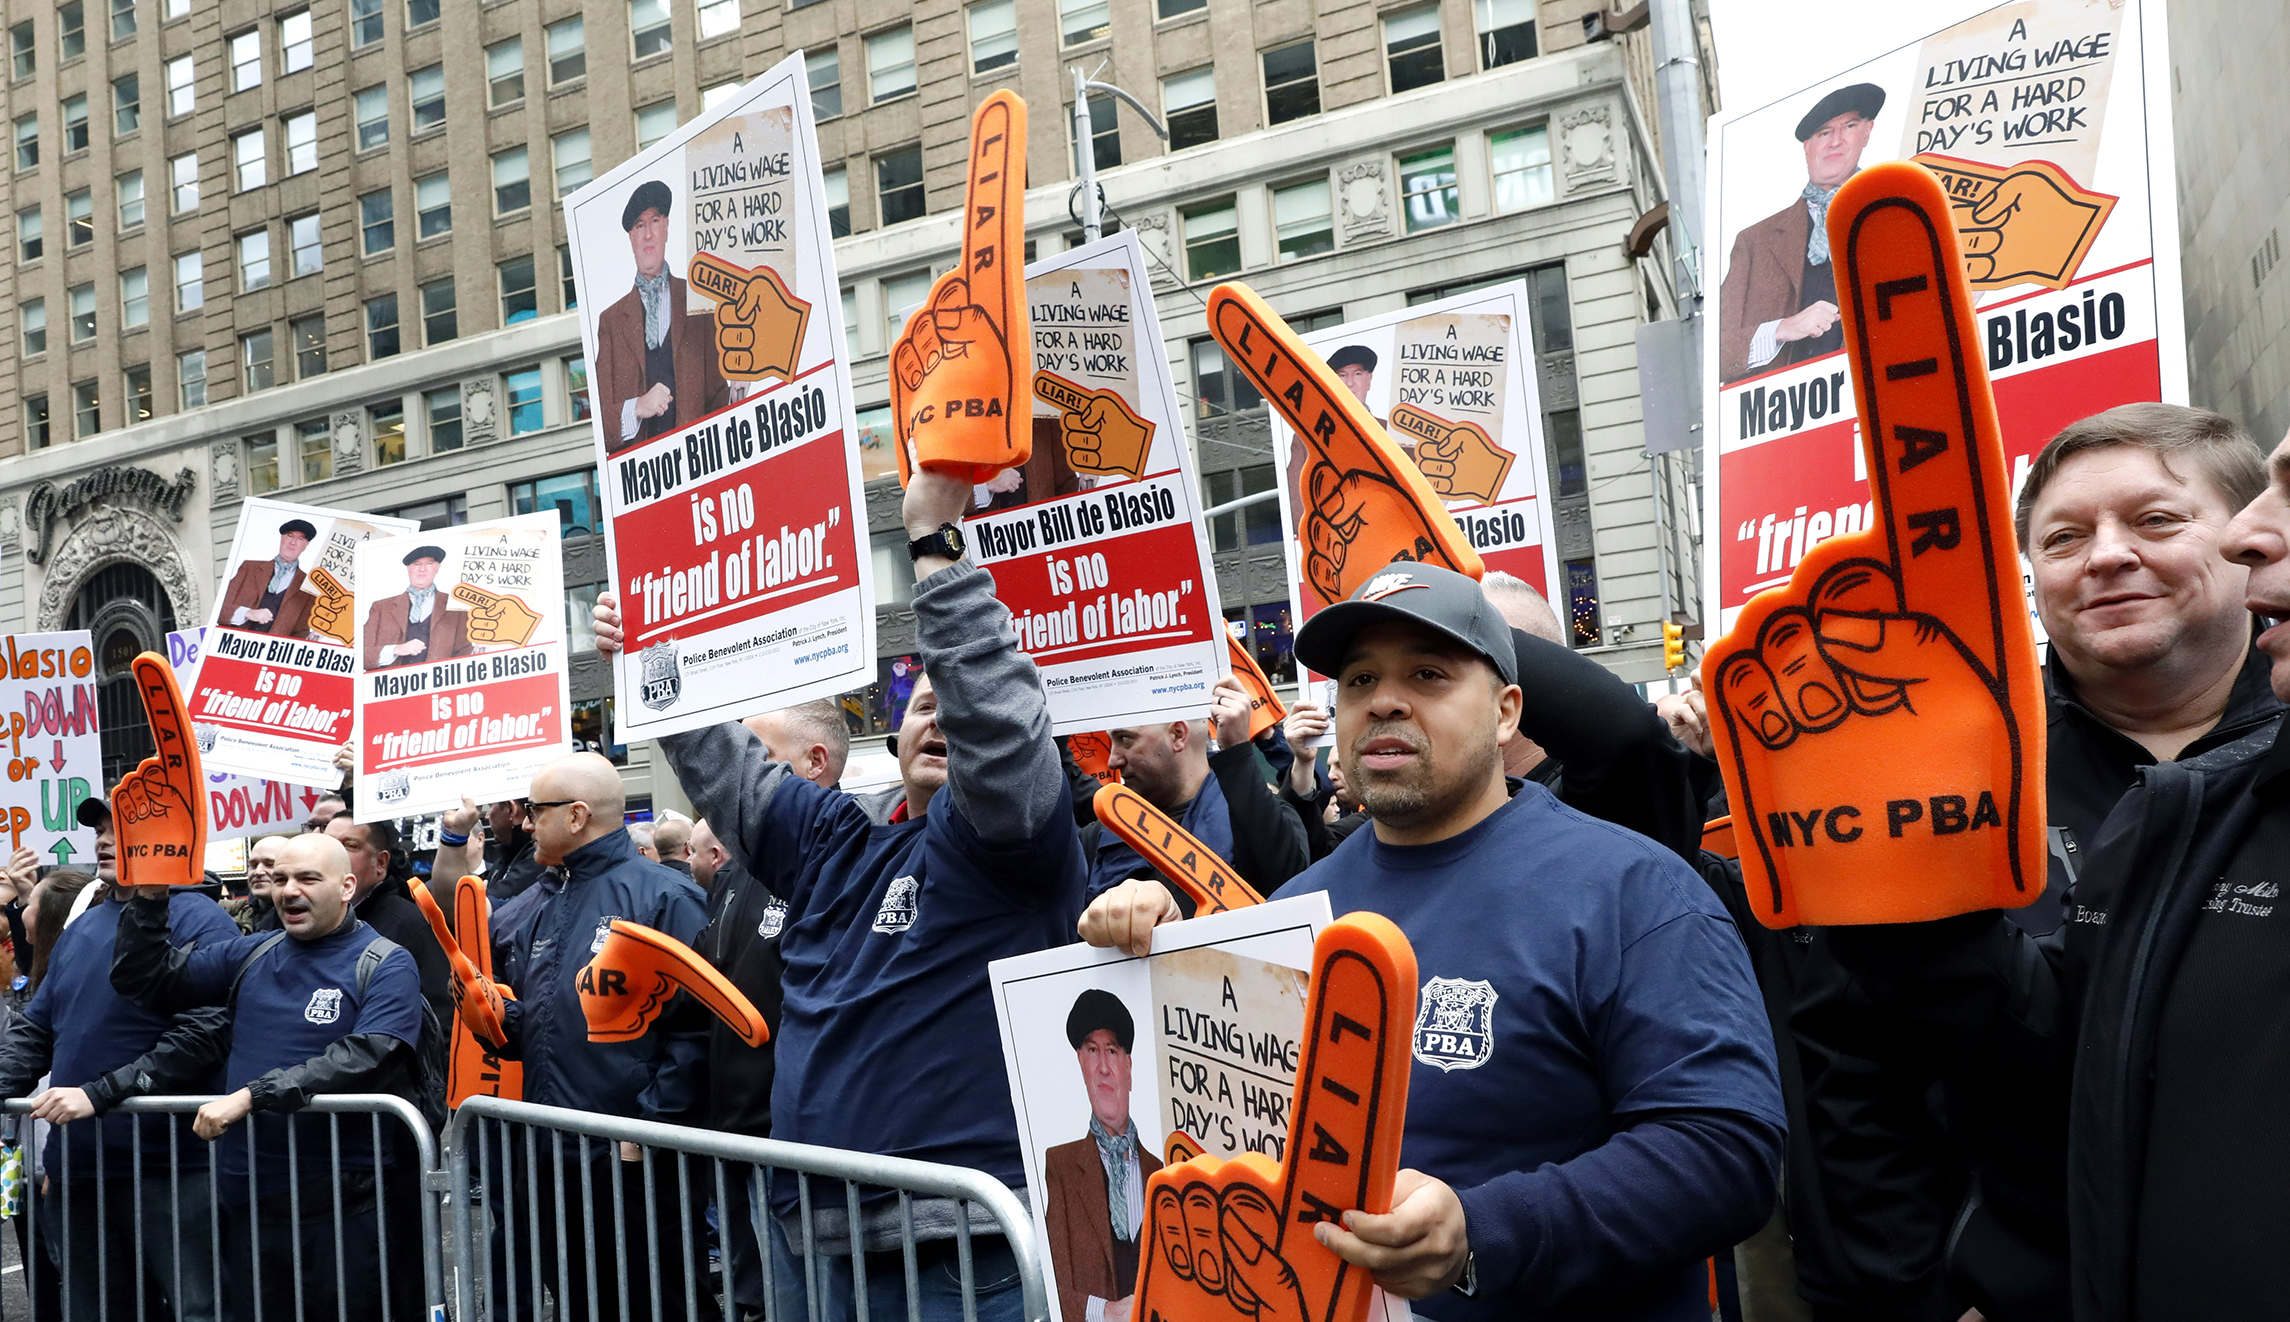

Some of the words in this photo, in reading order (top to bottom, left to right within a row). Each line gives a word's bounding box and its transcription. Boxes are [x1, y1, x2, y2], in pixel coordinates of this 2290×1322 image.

[2007, 18, 2028, 42] A
[1924, 48, 2026, 89] LIVING
[2034, 32, 2111, 67] WAGE
[1921, 93, 1972, 125] FOR
[1980, 89, 1999, 114] A
[2011, 76, 2086, 111] HARD
[733, 131, 743, 154] A
[1916, 119, 1994, 154] DAY'S
[2003, 106, 2087, 141] WORK
[692, 160, 747, 191] LIVING
[749, 152, 791, 179] WAGE
[1935, 172, 1982, 198] AR!
[695, 199, 724, 224] FOR
[727, 199, 737, 219] A
[743, 191, 782, 219] HARD
[974, 133, 1003, 275] LIAR
[695, 225, 737, 252] DAY'S
[742, 219, 787, 246] WORK
[698, 265, 737, 297] LIAR!
[1071, 281, 1082, 299] A
[1031, 304, 1085, 322] LIVING
[1090, 304, 1130, 323] WAGE
[1035, 331, 1063, 349] FOR
[1068, 332, 1078, 349] A
[1084, 333, 1122, 351] HARD
[1446, 324, 1457, 340] A
[1037, 353, 1079, 371] DAY'S
[1084, 353, 1129, 372] WORK
[1400, 344, 1458, 360] LIVING
[1462, 345, 1504, 363] WAGE
[1740, 369, 1845, 441] Mayor
[1987, 288, 2125, 371] Blasio
[1238, 322, 1336, 448] LIAR
[1400, 368, 1430, 384] FOR
[1435, 369, 1445, 385] A
[1452, 370, 1493, 387] HARD
[945, 397, 1003, 419] PBA
[1041, 381, 1082, 409] LIAR!
[1399, 388, 1444, 405] DAY'S
[1449, 390, 1495, 407] WORK
[1399, 413, 1441, 439] LIAR!
[1874, 274, 1961, 559] LIAR
[620, 447, 682, 506] Mayor
[685, 419, 723, 481] Bill
[725, 416, 752, 466] de
[754, 384, 827, 453] Blasio
[690, 492, 718, 546] is
[720, 482, 755, 536] no
[976, 516, 1037, 559] Mayor
[1037, 503, 1075, 546] Bill
[1075, 500, 1104, 538] de
[1104, 484, 1175, 531] Blasio
[362, 531, 371, 541] A
[499, 534, 507, 544] A
[325, 546, 344, 564] FOR
[345, 556, 353, 566] A
[464, 546, 507, 557] LIVING
[509, 548, 541, 559] WAGE
[630, 550, 720, 625] “friend
[725, 539, 751, 600] of
[755, 506, 841, 592] labor.”
[320, 557, 347, 577] DAY'S
[460, 573, 494, 585] DAY'S
[498, 574, 532, 586] WORK
[463, 561, 485, 571] FOR
[488, 562, 496, 572] A
[502, 563, 531, 574] HARD
[1045, 555, 1074, 596] is
[1074, 552, 1109, 591] no
[314, 573, 337, 597] LIAR!
[458, 589, 490, 606] LIAR!
[1082, 595, 1107, 641] of
[1111, 579, 1193, 635] labor.”
[217, 633, 266, 660] Mayor
[267, 640, 295, 664] Bill
[294, 645, 315, 667] de
[683, 652, 707, 667] Police
[708, 638, 751, 660] Benevolent
[752, 626, 798, 648] Association
[792, 638, 807, 648] Patrick
[827, 626, 847, 638] President
[794, 643, 849, 666] www.nycpba.org
[254, 666, 276, 693] is
[275, 673, 302, 697] no
[374, 672, 428, 698] Mayor
[433, 663, 461, 688] Bill
[467, 659, 487, 683] de
[493, 650, 547, 678] Blasio
[1046, 678, 1069, 688] Police
[1069, 671, 1110, 684] Benevolent
[1111, 664, 1154, 678] Association
[1183, 668, 1203, 676] President
[648, 679, 676, 701] PBA
[1151, 681, 1205, 694] www.nycpba.org
[25, 683, 98, 739] DOWN
[200, 687, 268, 721] “friend
[263, 700, 290, 725] of
[283, 704, 351, 734] labor.”
[432, 694, 452, 721] is
[456, 691, 484, 717] no
[148, 685, 183, 769] LIAR
[372, 723, 451, 761] “friend
[453, 718, 478, 749] of
[479, 706, 552, 745] labor.”
[220, 735, 237, 743] Police
[238, 738, 268, 749] Benevolent
[269, 743, 300, 753] Association
[7, 757, 40, 782] or
[413, 772, 433, 781] Police
[435, 767, 471, 779] Benevolent
[473, 761, 510, 772] Association
[41, 777, 91, 831] UP
[211, 780, 293, 832] DOWN
[382, 787, 404, 799] PBA
[1767, 805, 1863, 848] NYC
[1886, 790, 2001, 838] PBA
[127, 845, 148, 858] NYC
[153, 844, 188, 857] PBA
[1136, 810, 1226, 896] LIAR
[876, 912, 908, 924] PBA
[1222, 975, 1239, 1013] A
[310, 1009, 332, 1019] PBA
[1163, 1004, 1245, 1060] LIVING
[1248, 1032, 1300, 1073] WAG
[1423, 1033, 1475, 1056] PBA
[1169, 1055, 1213, 1101] FOR
[1218, 1071, 1235, 1109] A
[1241, 1080, 1292, 1132] HAR
[1171, 1097, 1236, 1151] DAY'S
[1297, 1011, 1372, 1225] LIAR
